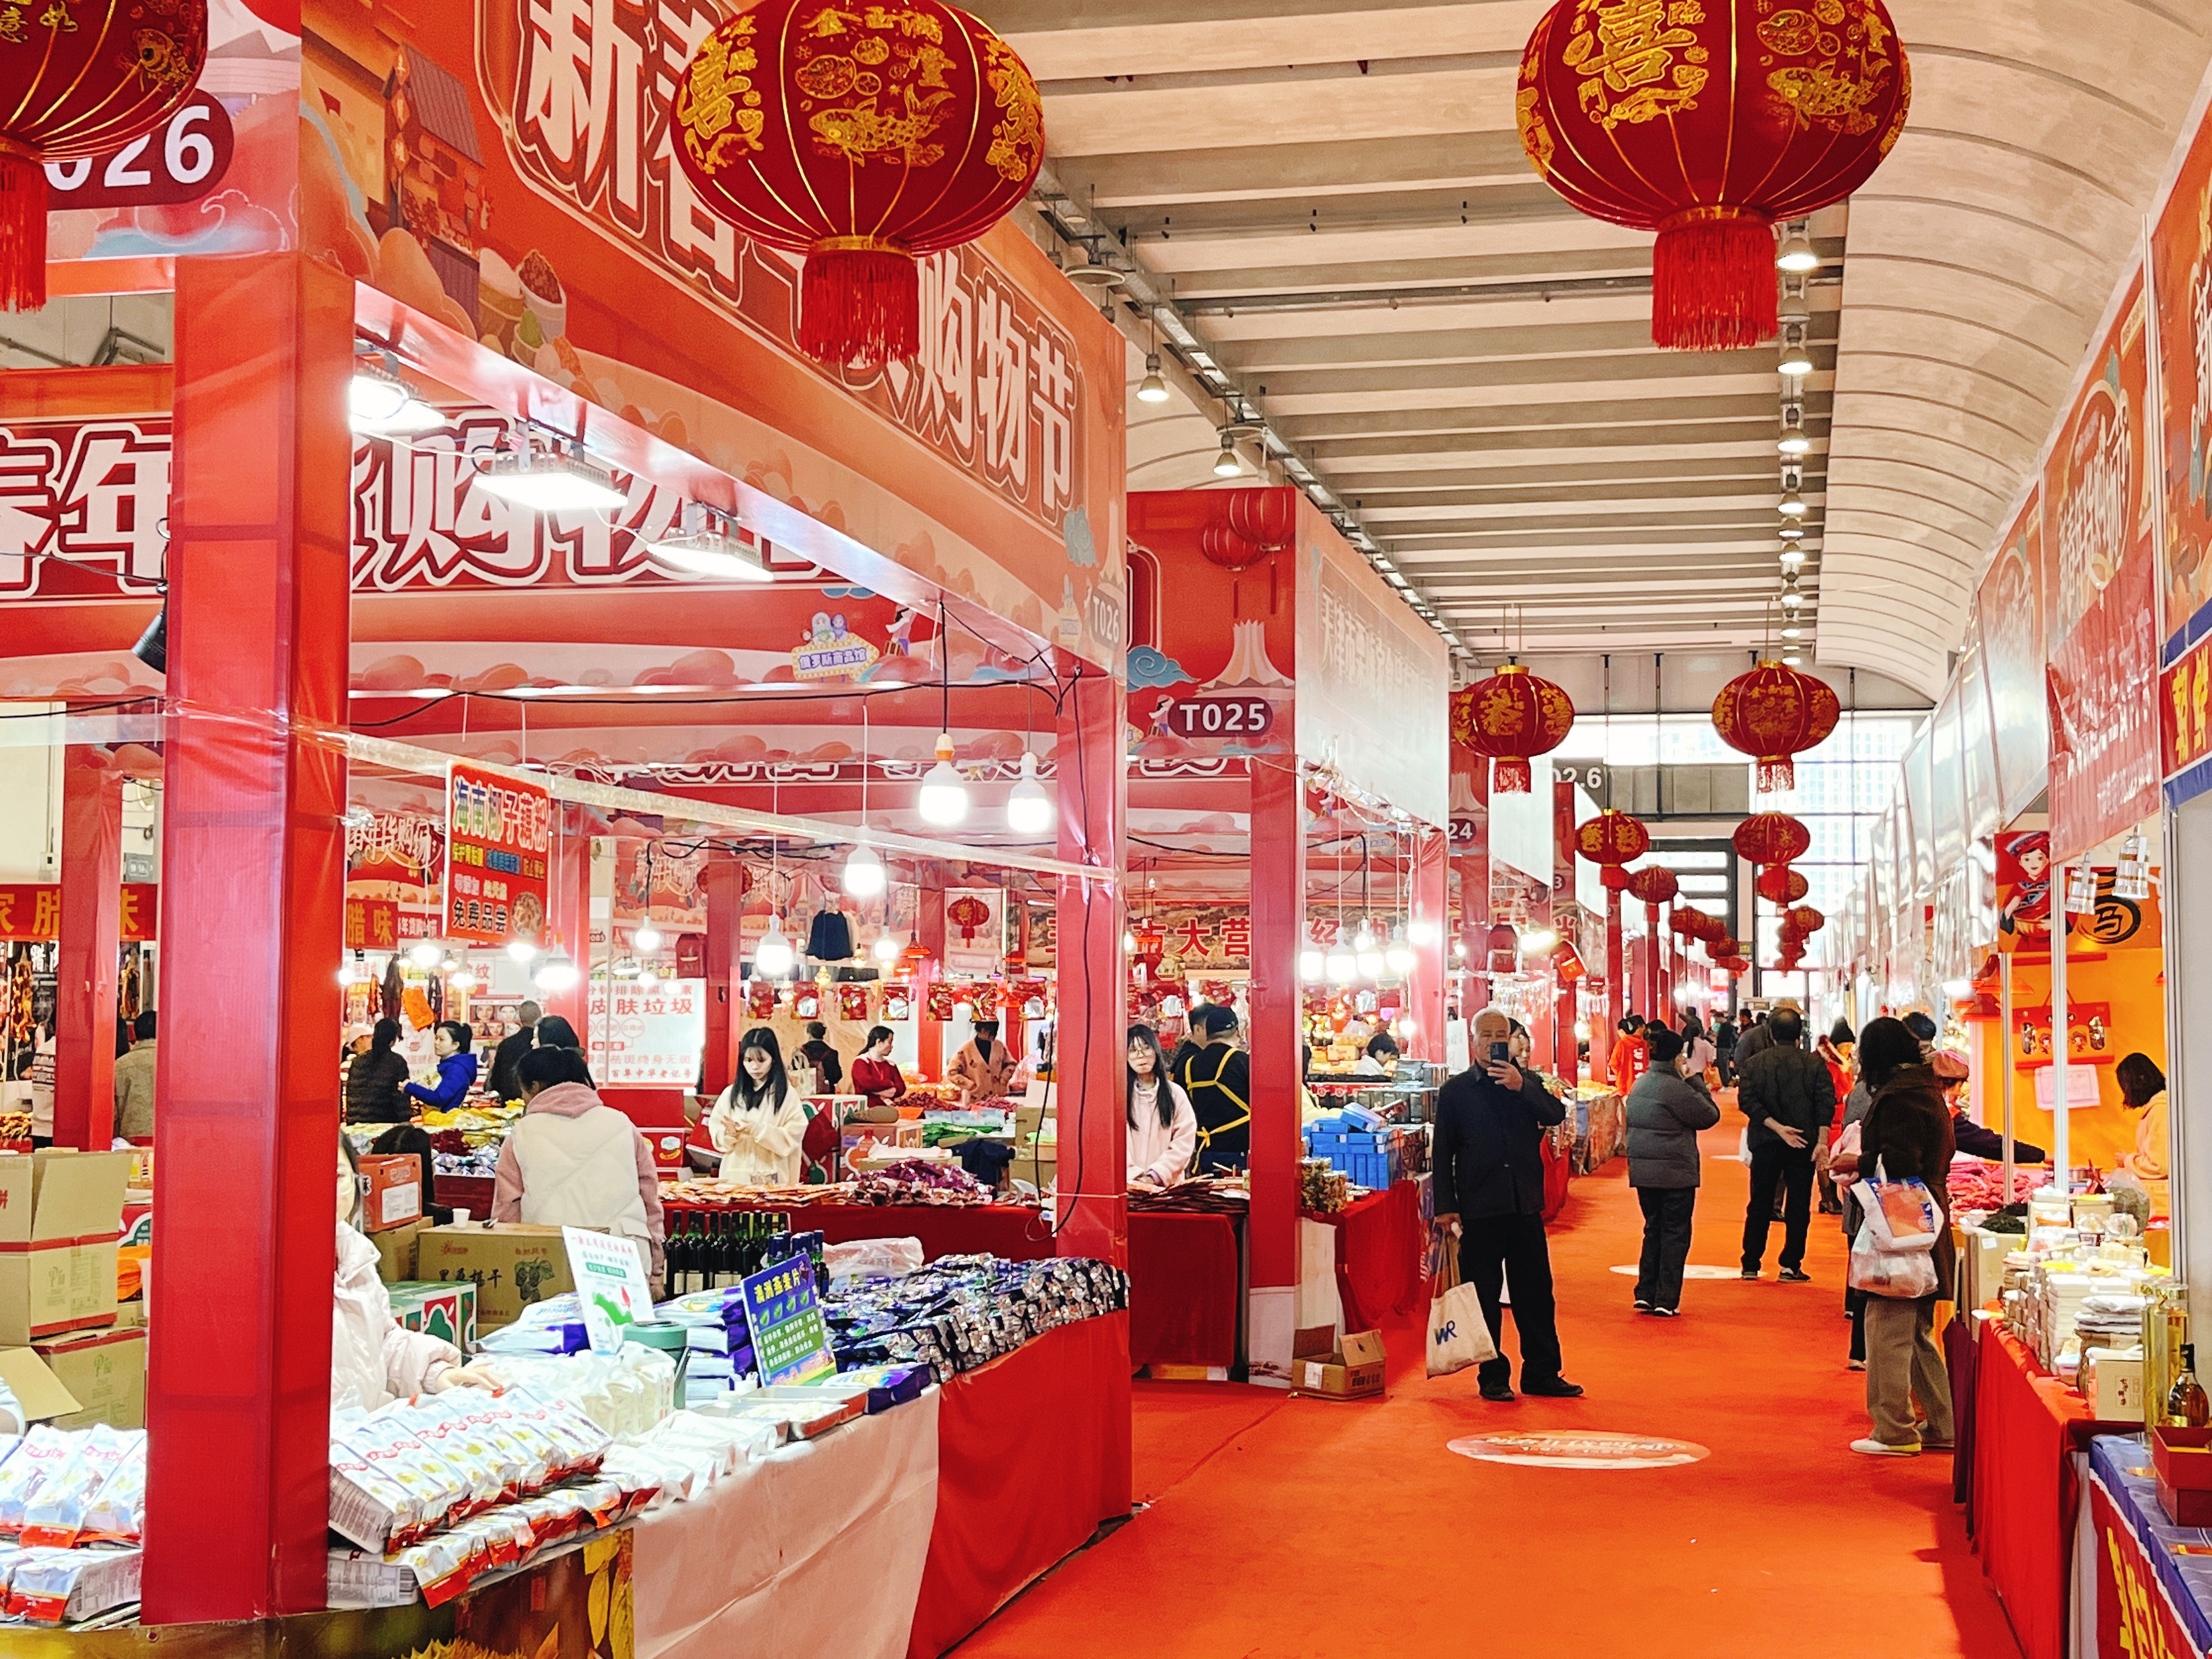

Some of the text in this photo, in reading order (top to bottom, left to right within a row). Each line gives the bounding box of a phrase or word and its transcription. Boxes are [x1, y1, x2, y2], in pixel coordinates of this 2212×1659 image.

[1092, 594, 1120, 651] T026
[1180, 703, 1266, 731] T025
[347, 902, 393, 945] 腊味
[452, 897, 508, 935] 免费品尝
[2094, 906, 2123, 935] 马
[590, 998, 693, 1015] 皮肤垃圾
